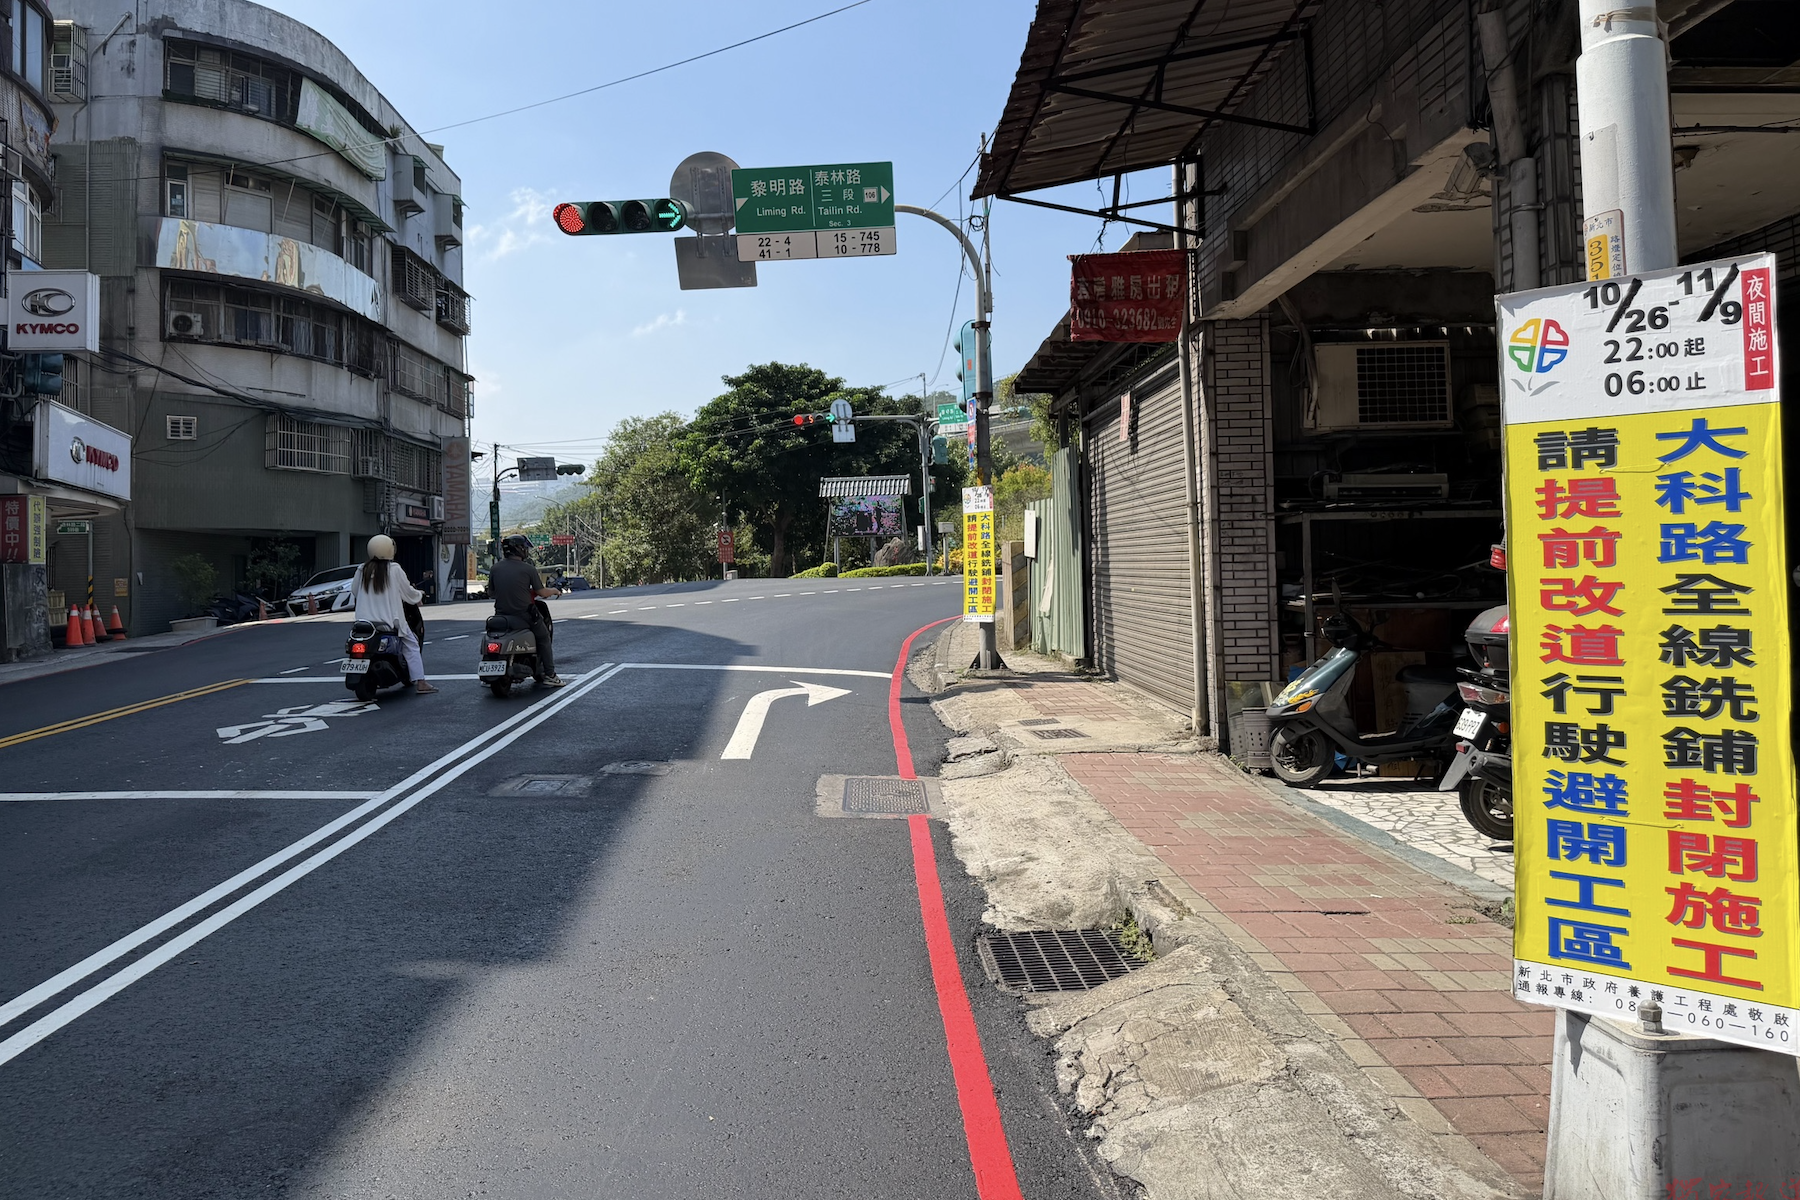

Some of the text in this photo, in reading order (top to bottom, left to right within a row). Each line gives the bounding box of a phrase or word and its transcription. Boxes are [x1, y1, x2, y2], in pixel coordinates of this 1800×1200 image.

[751, 178, 805, 198] 黎明路
[814, 169, 861, 187] 泰林路
[821, 188, 855, 202] 三段
[756, 205, 806, 217] Liming Rd.
[818, 205, 863, 216] Tailin Rd.
[847, 219, 851, 227] 3
[1589, 217, 1613, 232] 新北市
[1077, 274, 1180, 301] 套房雅房出租
[16, 323, 80, 335] KYMCO
[1746, 273, 1770, 377] 夜間施工
[85, 444, 119, 473] KYMCO
[445, 463, 467, 522] YAMAHA
[1533, 426, 1633, 971] 請提前改道行駛避開工區
[1654, 417, 1765, 991] 大科路全線銑鋪封閉施工
[1518, 964, 1790, 1028] 新北市政府養護工程處敬啟
